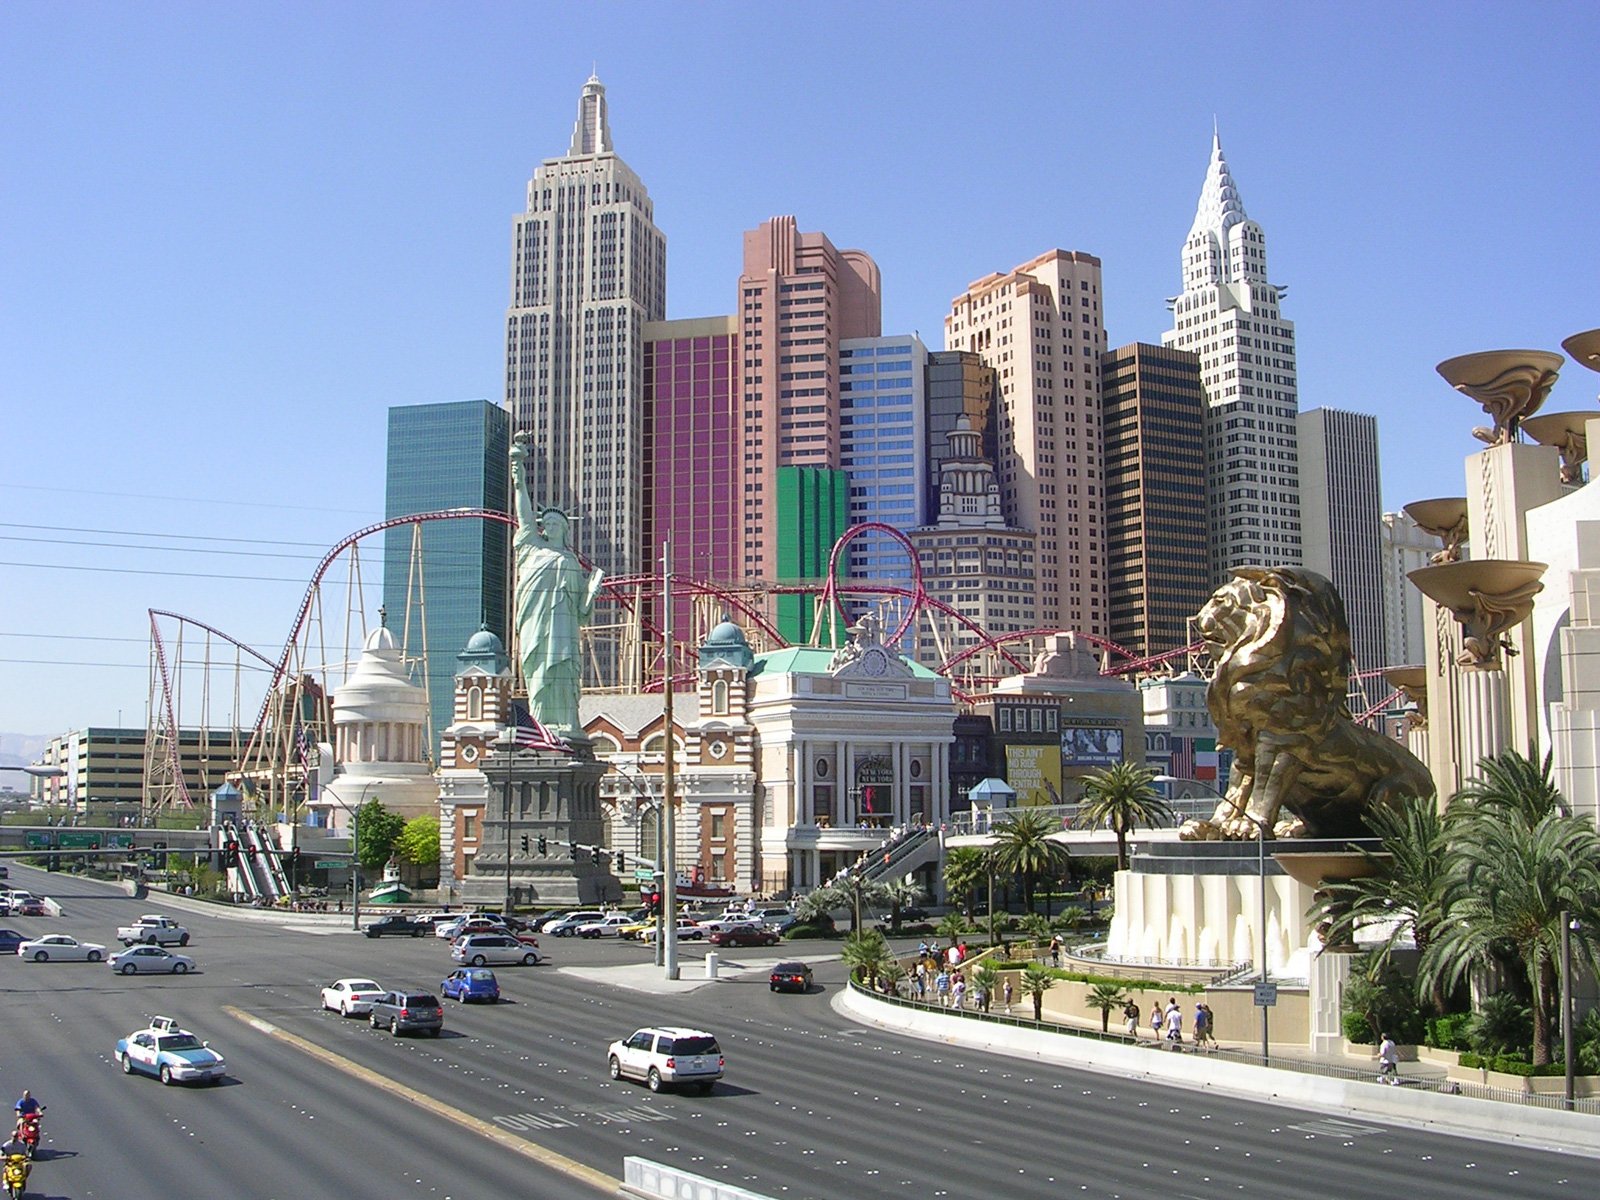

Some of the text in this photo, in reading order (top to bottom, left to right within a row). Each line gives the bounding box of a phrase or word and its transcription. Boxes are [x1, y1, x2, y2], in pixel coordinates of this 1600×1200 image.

[1008, 748, 1044, 758] THIS AIN'T
[1009, 758, 1037, 768] NO RIDE
[1009, 768, 1041, 779] THROUGH
[1009, 779, 1041, 789] CENTRAL
[492, 1112, 579, 1131] ONLY
